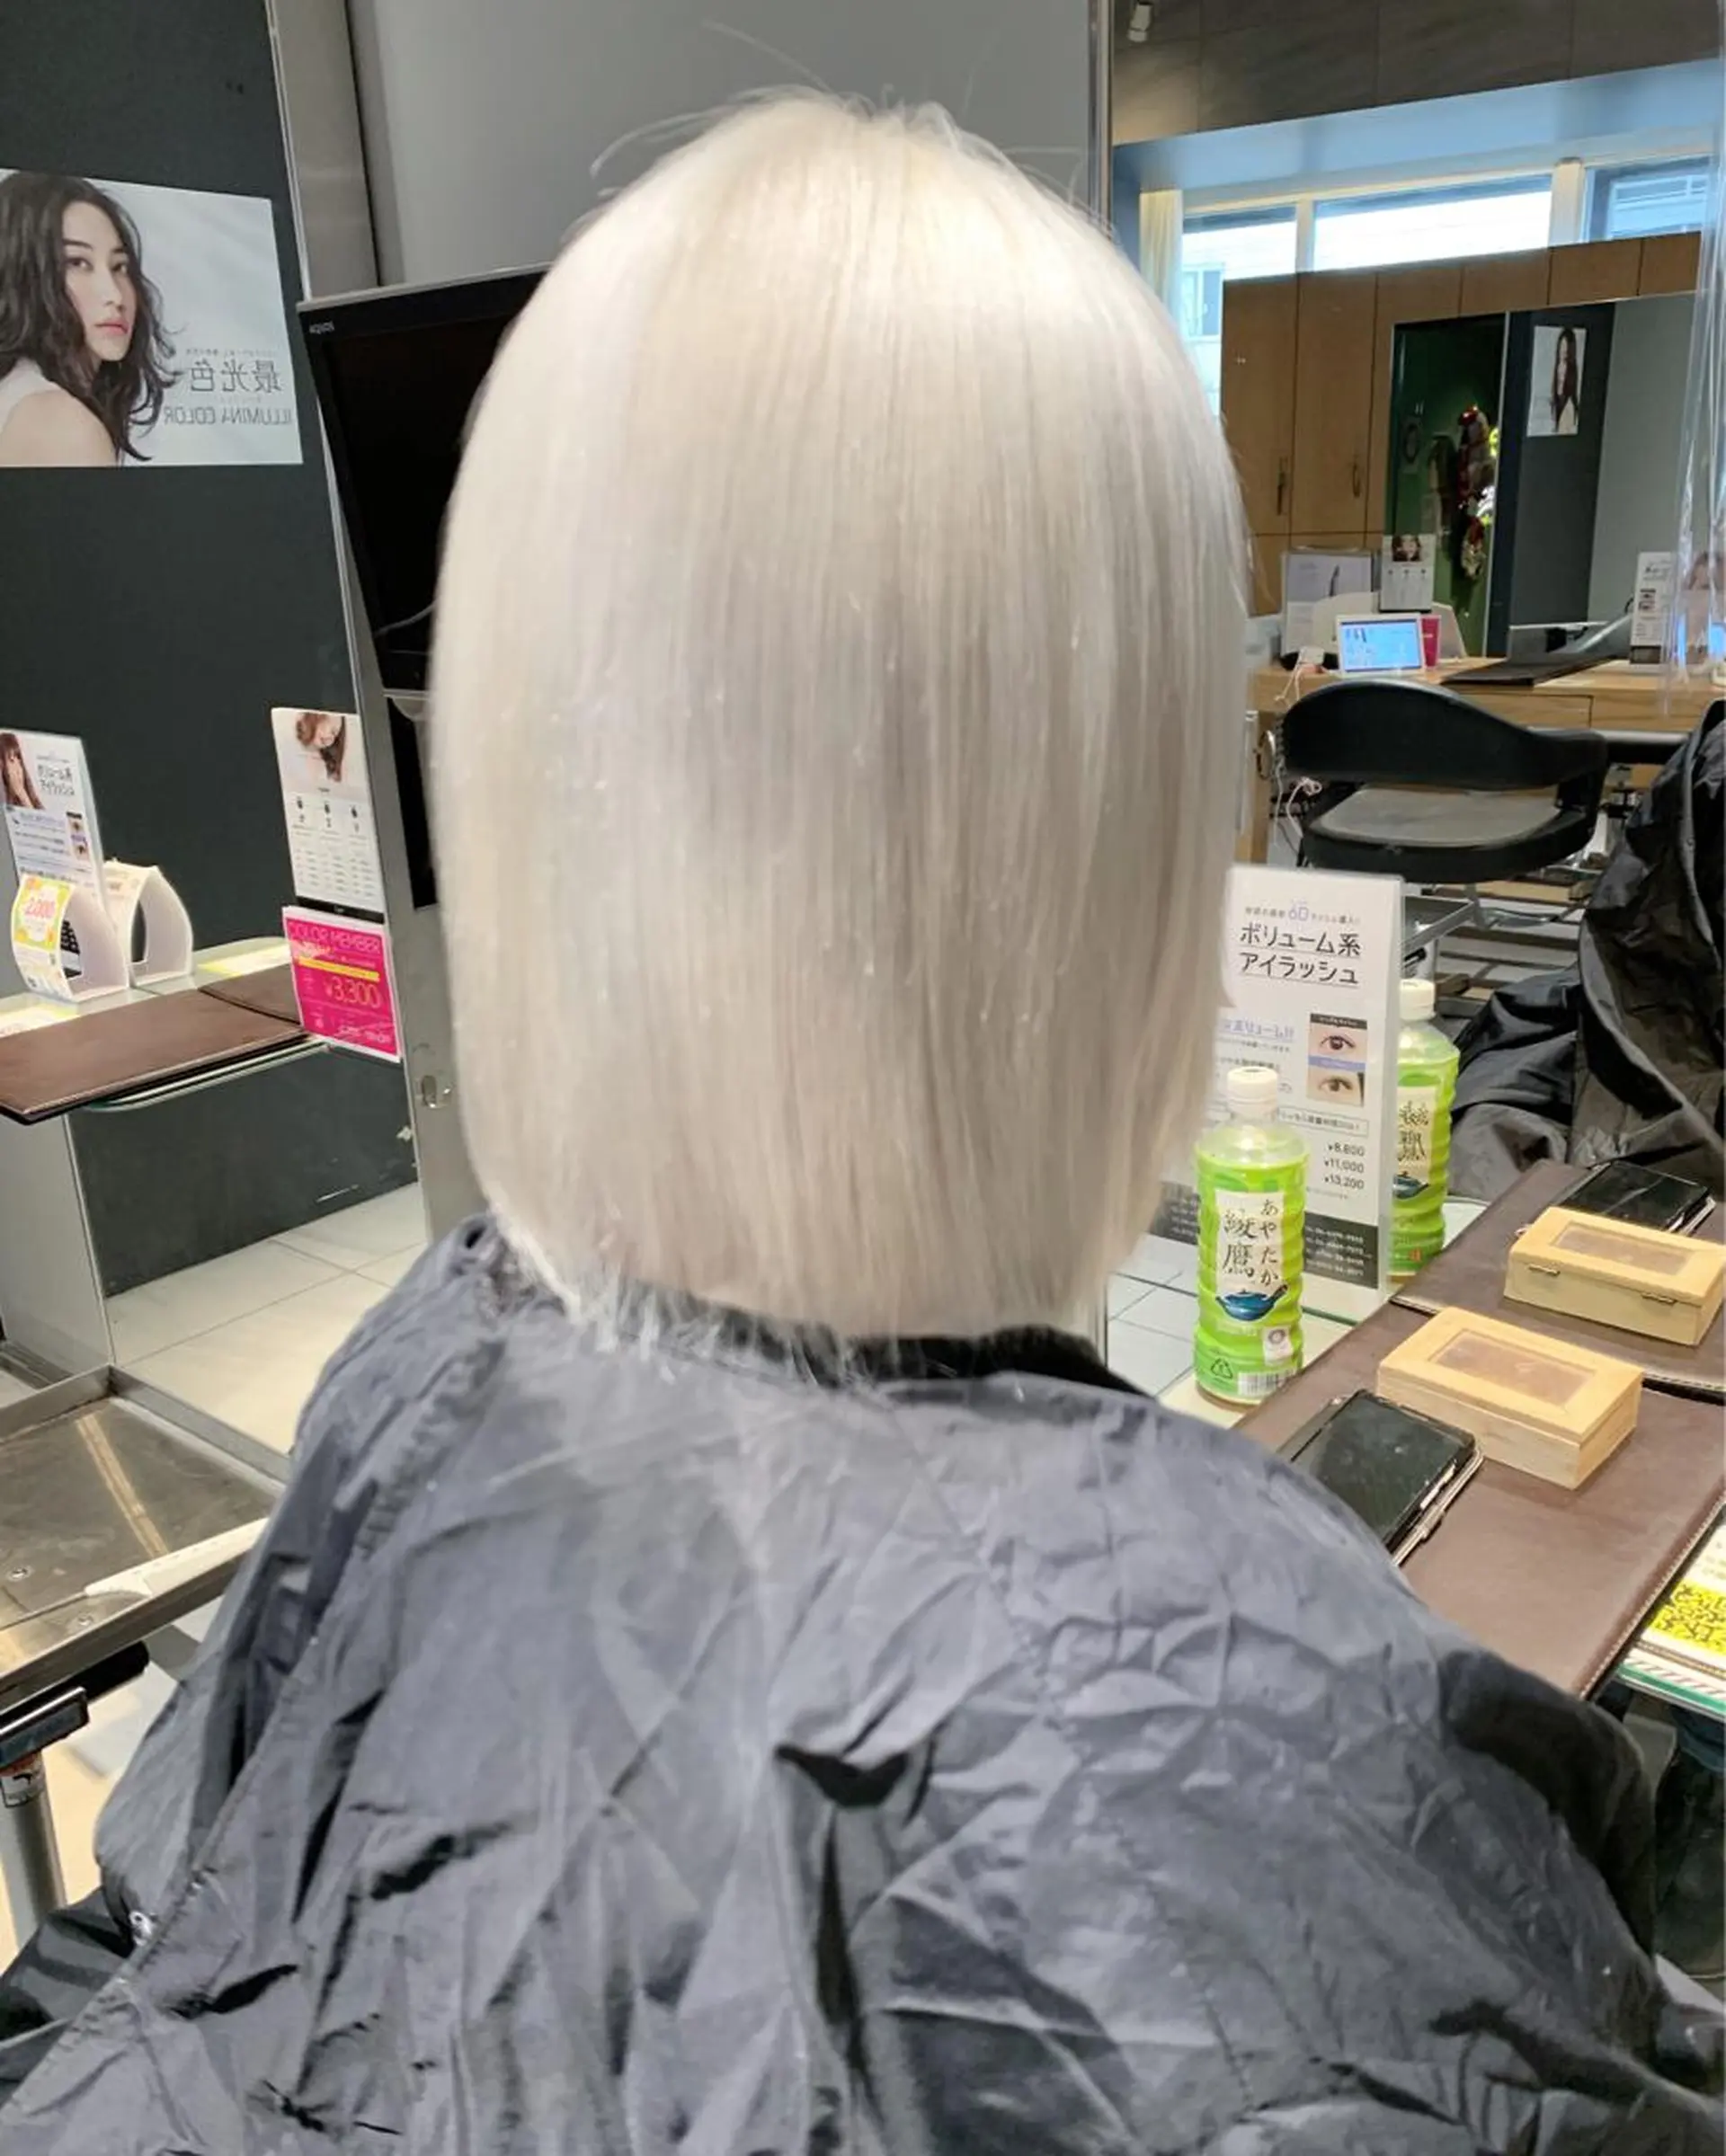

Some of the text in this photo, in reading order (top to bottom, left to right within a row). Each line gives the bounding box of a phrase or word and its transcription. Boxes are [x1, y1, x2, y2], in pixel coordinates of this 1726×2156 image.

[1240, 922, 1360, 957] ボリューム系
[1240, 952, 1358, 984] アイラッシュ
[1223, 1209, 1258, 1278] 綾鷹
[1259, 1198, 1279, 1286] あやたか
